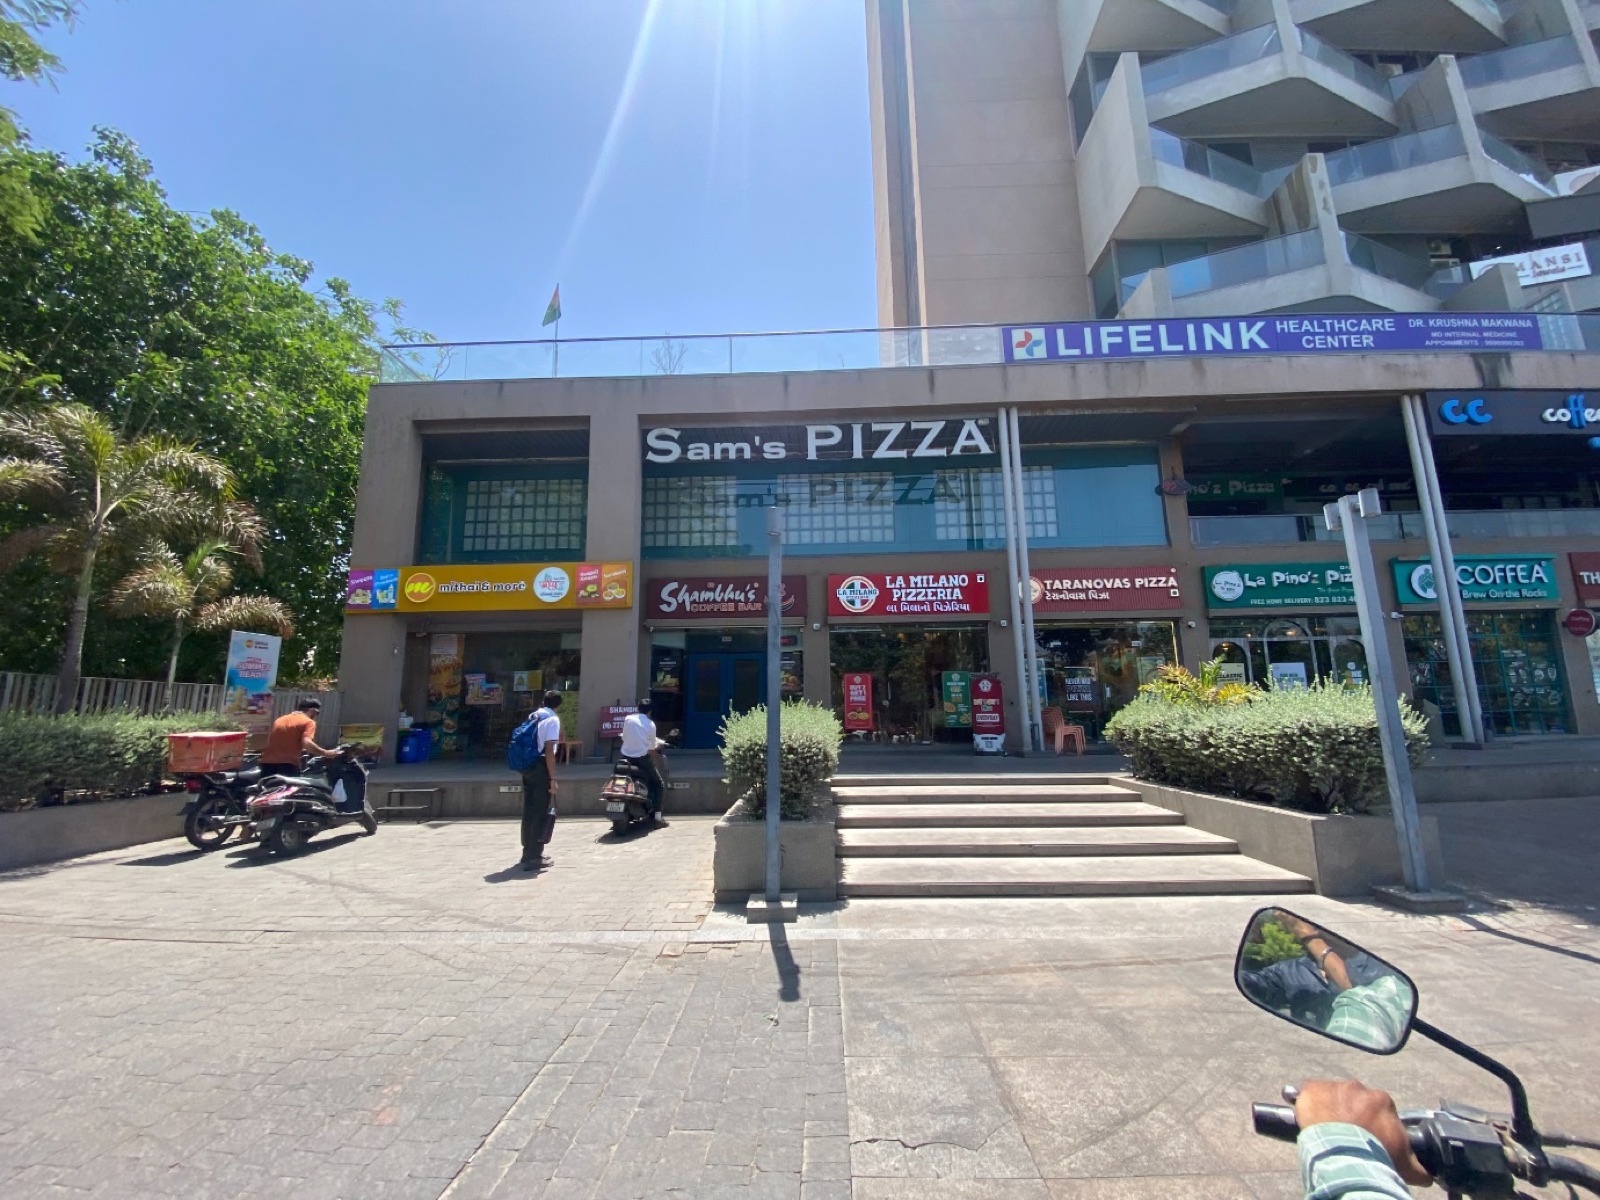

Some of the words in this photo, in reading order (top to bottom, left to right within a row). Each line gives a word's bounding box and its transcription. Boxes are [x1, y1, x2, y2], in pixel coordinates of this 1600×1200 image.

[1275, 318, 1396, 333] HEALTHCARE
[1408, 319, 1426, 328] DR.
[1428, 319, 1479, 328] KRUSHNA
[1481, 319, 1533, 328] MAKWANA
[1056, 321, 1270, 356] LIFELINK
[1301, 335, 1375, 348] CENTER
[646, 427, 787, 464] Sam's
[806, 419, 995, 461] PIZZA
[885, 575, 906, 588] LA
[909, 574, 969, 588] MILANO
[1243, 573, 1266, 588] La
[1272, 571, 1319, 588] Pino'z
[1325, 569, 1353, 586] Piz
[1455, 564, 1549, 585] COFFEA
[438, 581, 480, 593] mithai
[481, 582, 490, 592] &
[493, 581, 526, 592] more
[1044, 578, 1131, 590] TARANOVAS
[1134, 576, 1178, 589] PIZZA
[658, 581, 756, 612] Shambhu's
[849, 588, 877, 596] MILANO
[892, 588, 963, 601] PIZZERIA
[1462, 589, 1487, 599] Brew
[1489, 589, 1504, 598] On
[1504, 589, 1520, 598] the
[1521, 588, 1547, 598] Rocks
[690, 603, 735, 612] COFFEE
[737, 602, 762, 611] BAR
